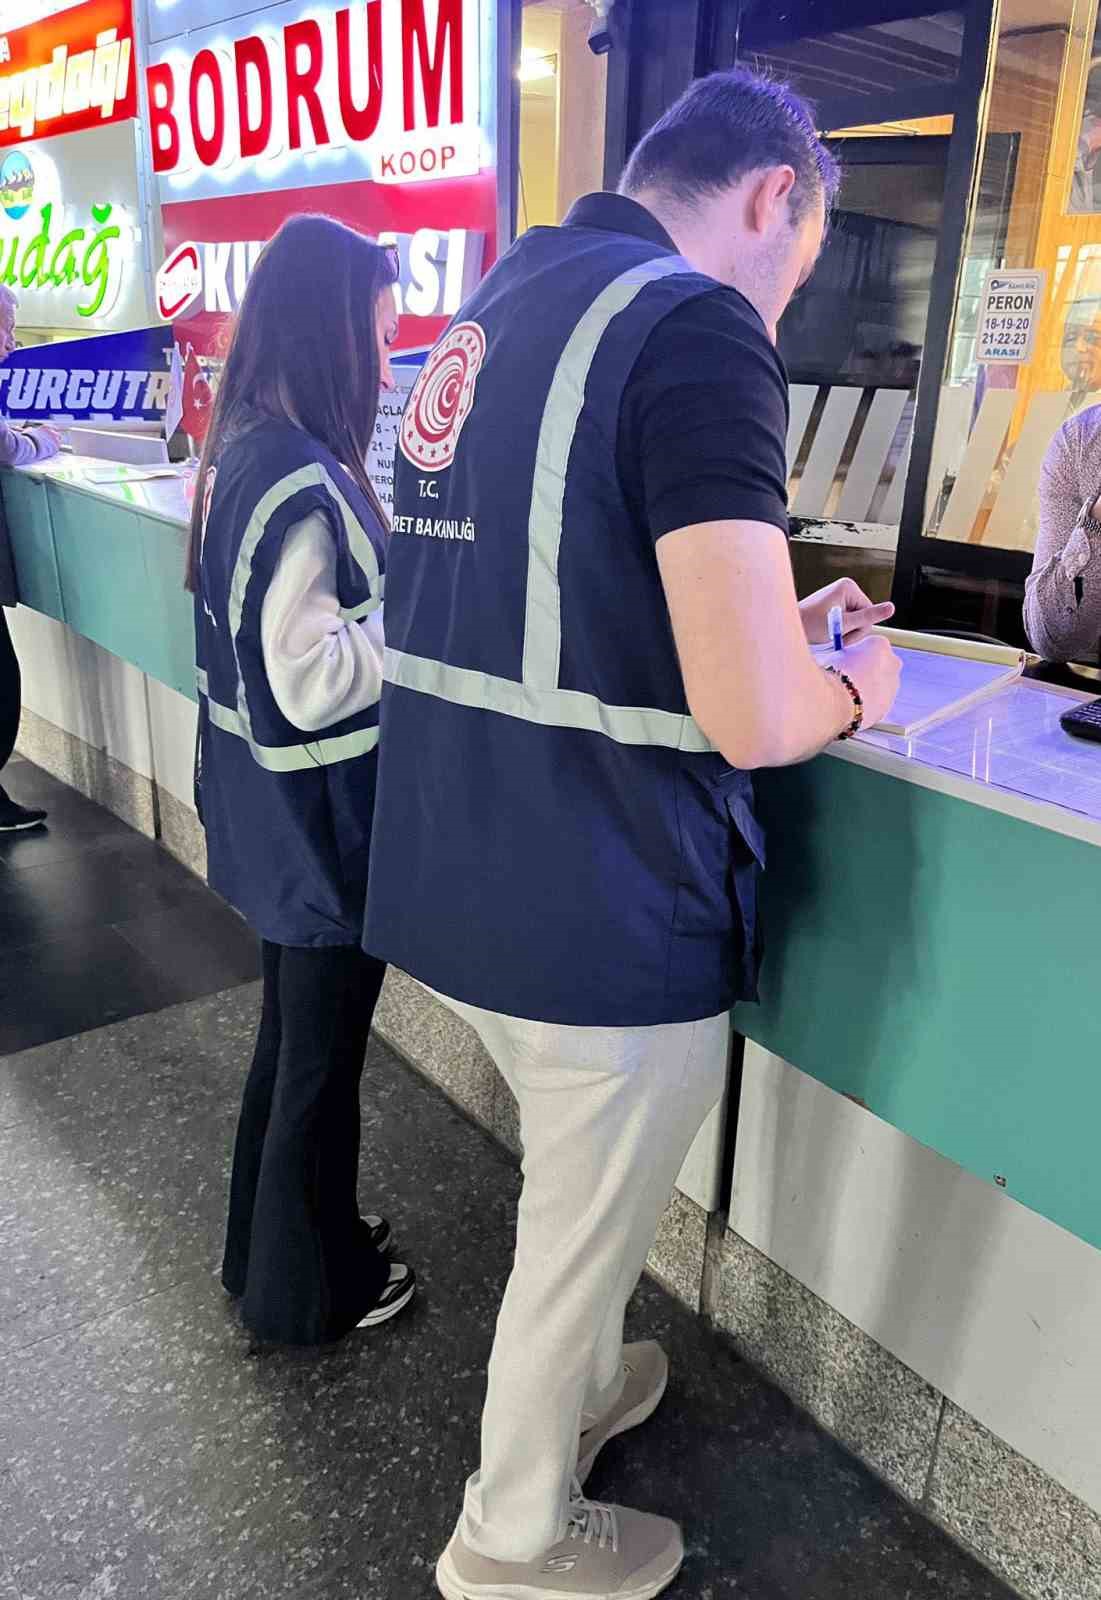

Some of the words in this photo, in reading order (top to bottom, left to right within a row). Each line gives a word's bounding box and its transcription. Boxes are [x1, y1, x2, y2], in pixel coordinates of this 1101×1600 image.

[146, 0, 464, 172] BODRUM
[380, 146, 456, 177] KOOP
[987, 296, 1034, 310] PERON
[985, 348, 1020, 357] ARASI
[418, 479, 439, 499] T.C.
